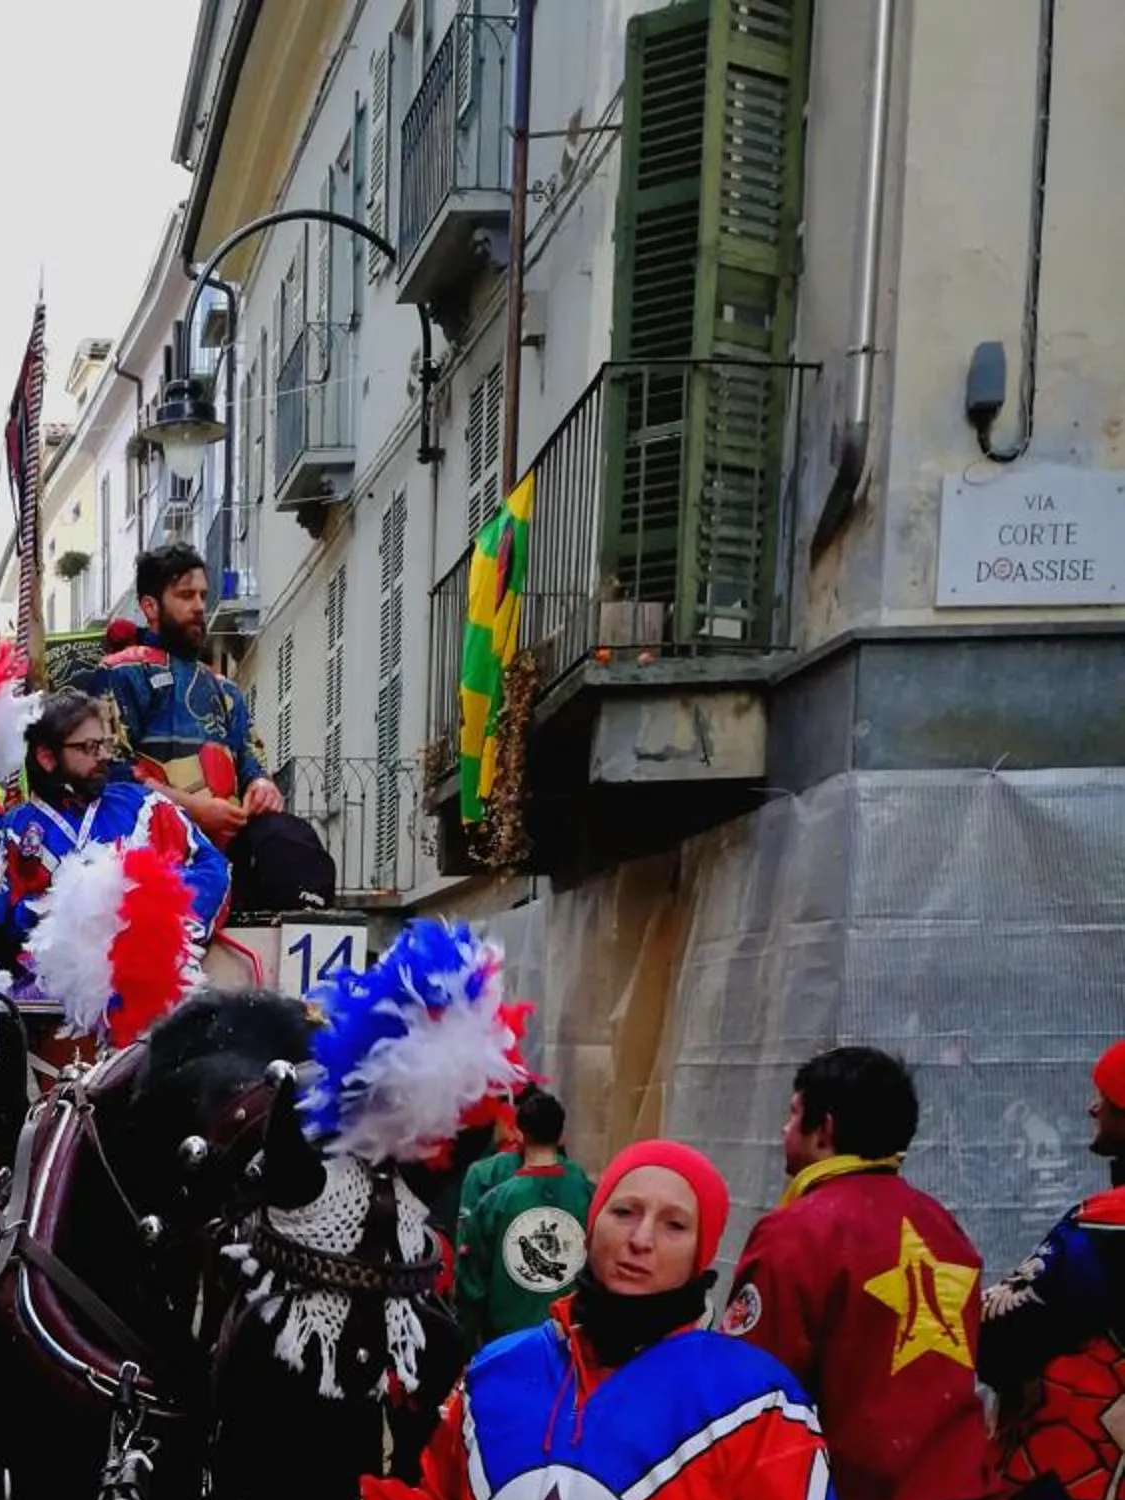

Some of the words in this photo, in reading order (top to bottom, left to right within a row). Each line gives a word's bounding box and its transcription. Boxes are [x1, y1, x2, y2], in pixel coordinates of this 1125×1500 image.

[1024, 495, 1055, 511] VIA
[998, 522, 1079, 546] CORTE
[976, 558, 1096, 583] DASSISE
[288, 933, 353, 995] 14
